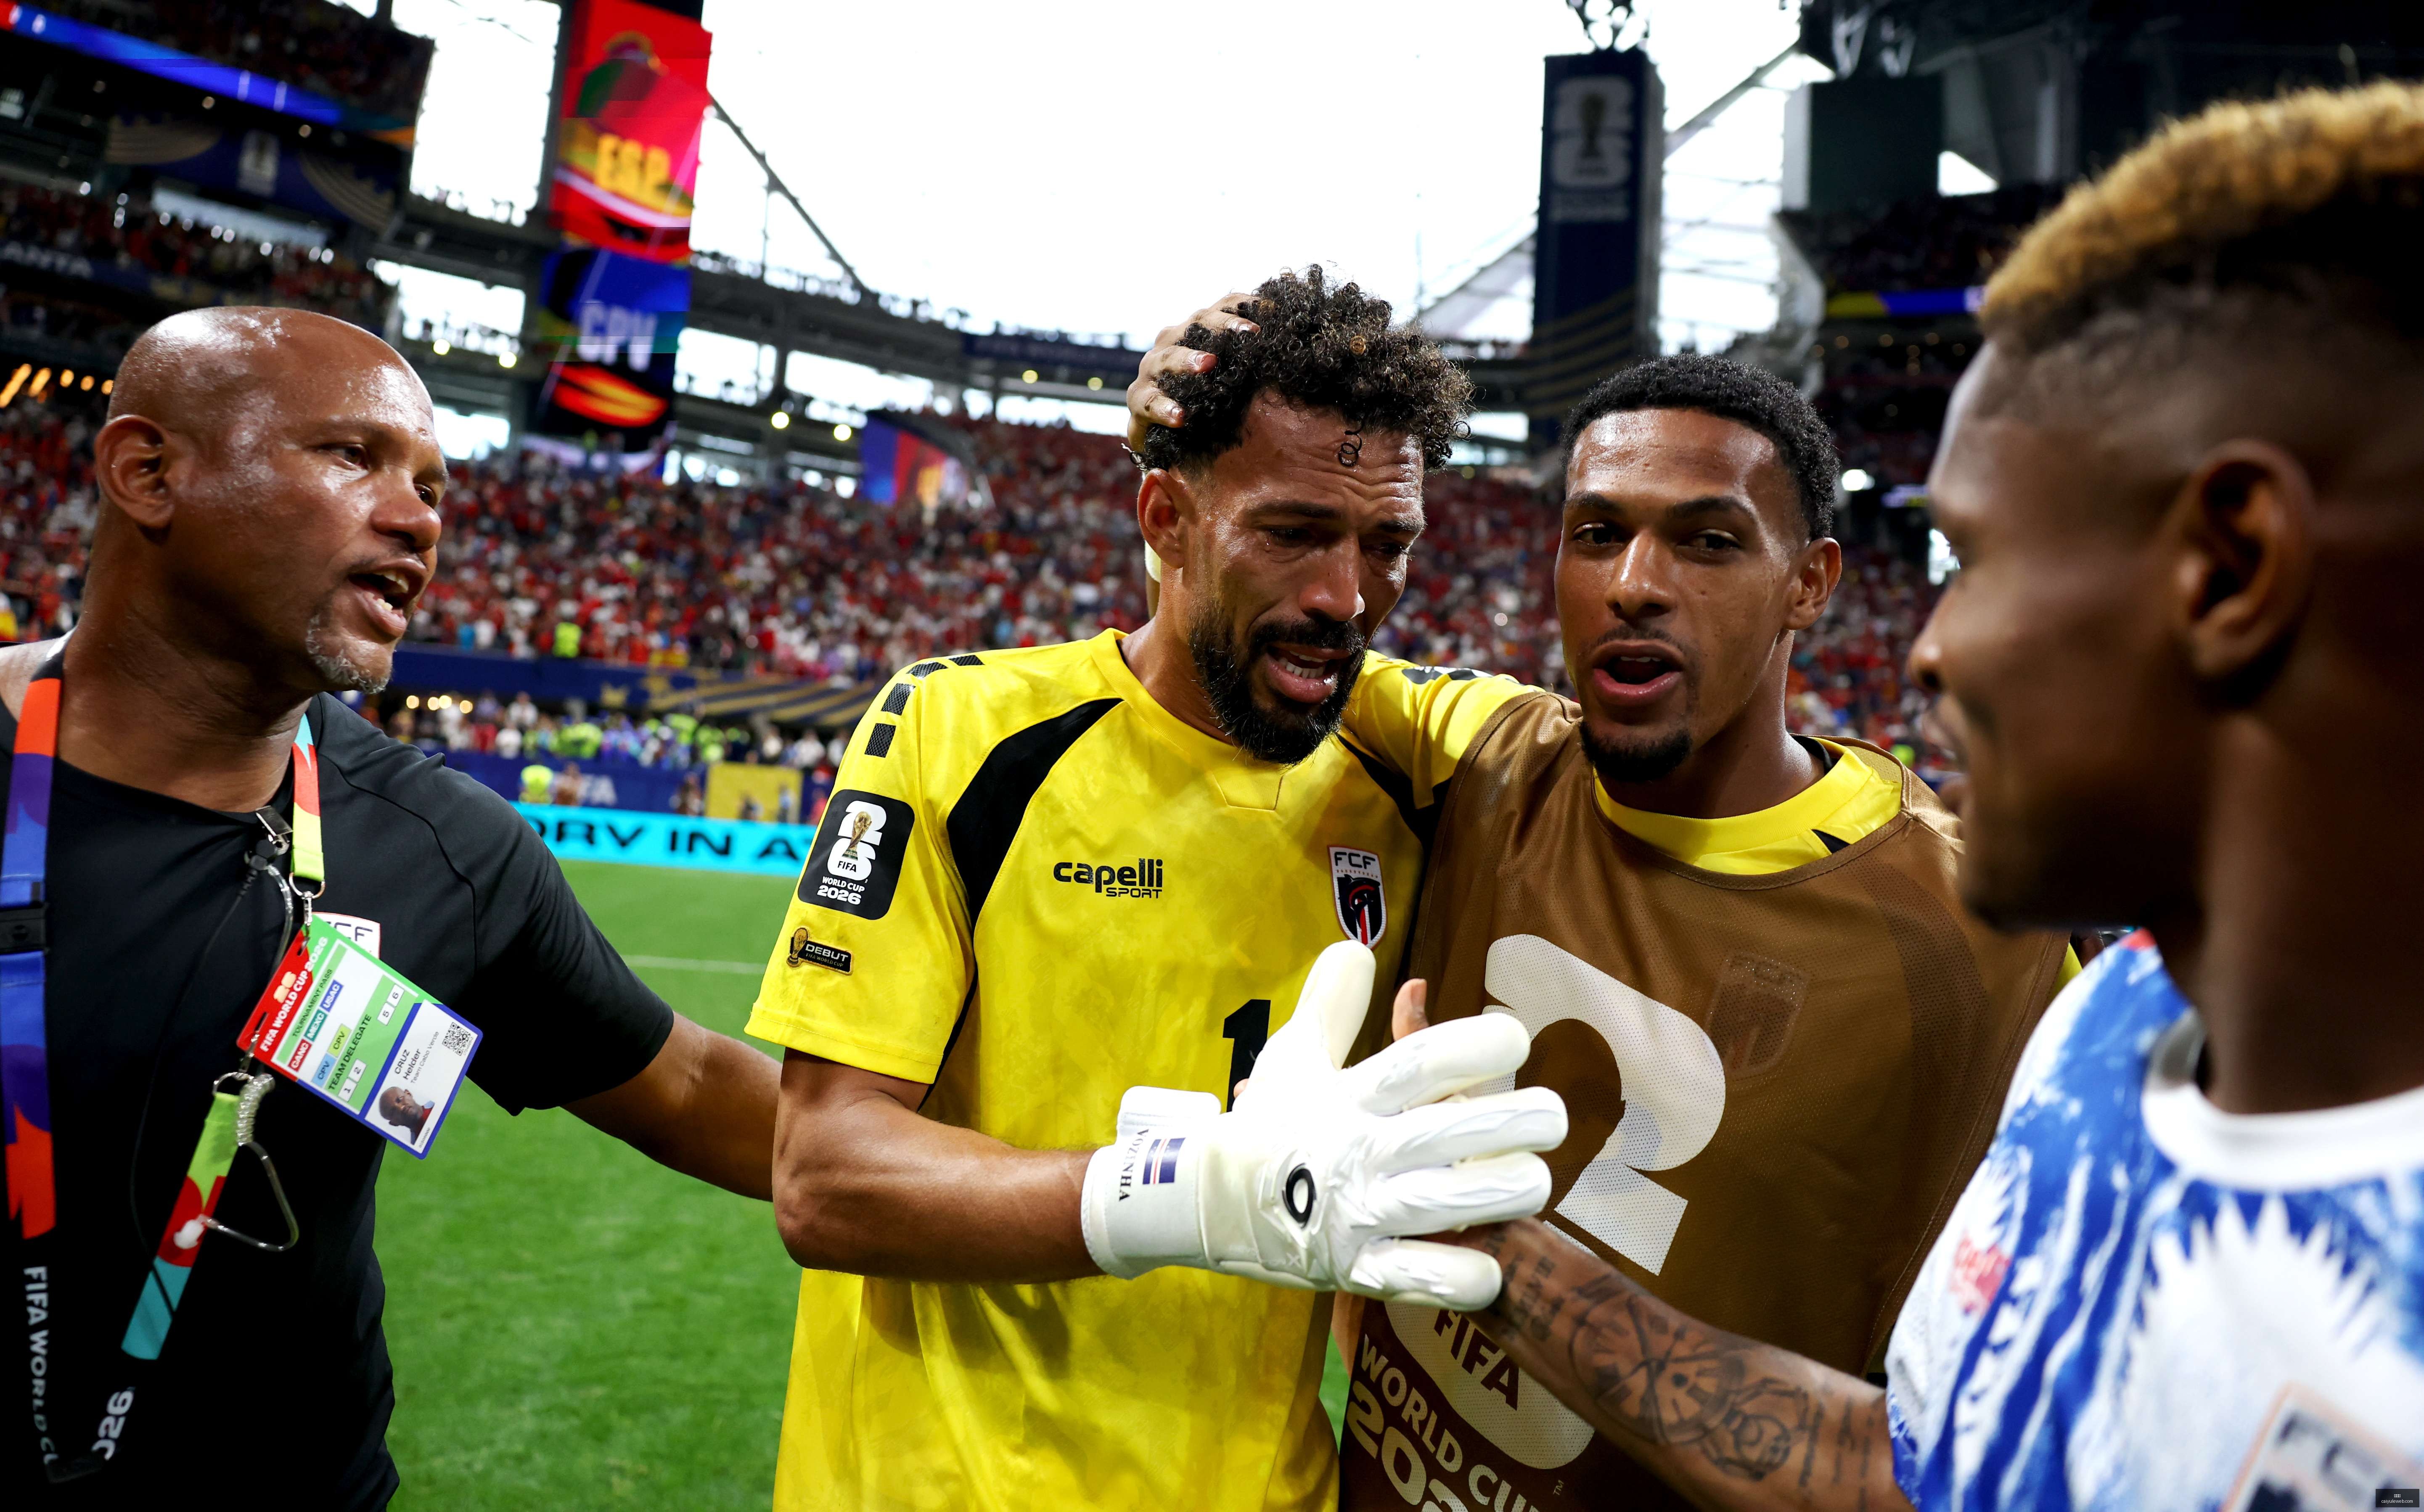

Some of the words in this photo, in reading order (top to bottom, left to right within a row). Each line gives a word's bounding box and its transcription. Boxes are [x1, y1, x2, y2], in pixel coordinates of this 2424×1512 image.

[595, 134, 672, 198] ESP
[576, 299, 658, 372] CPV
[670, 829, 732, 856] IN
[838, 861, 857, 872] FIFA
[1053, 858, 1163, 893] capelli
[1334, 852, 1376, 869] FCF
[817, 885, 862, 905] 2026
[822, 876, 847, 888] WORLD
[847, 883, 865, 893] CUP
[1106, 888, 1162, 899] SPORT
[805, 944, 848, 962] DEBUT
[817, 955, 834, 964] WORLD
[260, 1027, 279, 1052] FIFA
[274, 991, 298, 1028] WORLD
[295, 970, 308, 992] CUP
[304, 937, 328, 971] 2026
[293, 988, 320, 1037] TOURNAMENT
[320, 969, 333, 989] PASS
[318, 1061, 330, 1080] CPV
[333, 1031, 346, 1049] CPV
[328, 1063, 347, 1090] TEAM
[344, 1014, 371, 1062] DELEGATE
[394, 1049, 410, 1074] CRUZ
[402, 1048, 421, 1080] Helder
[410, 1065, 421, 1084] Team
[419, 1050, 431, 1068] Cabo
[1223, 999, 1271, 1113] 1
[1119, 1129, 1149, 1202] VOZINHA
[24, 1266, 50, 1326] FIFA
[1434, 1309, 1519, 1412] FIFA
[29, 1330, 49, 1432] WORLD
[1361, 1333, 1463, 1472] WORLD
[1469, 1464, 1542, 1512] CU
[1553, 1479, 1565, 1496] TM
